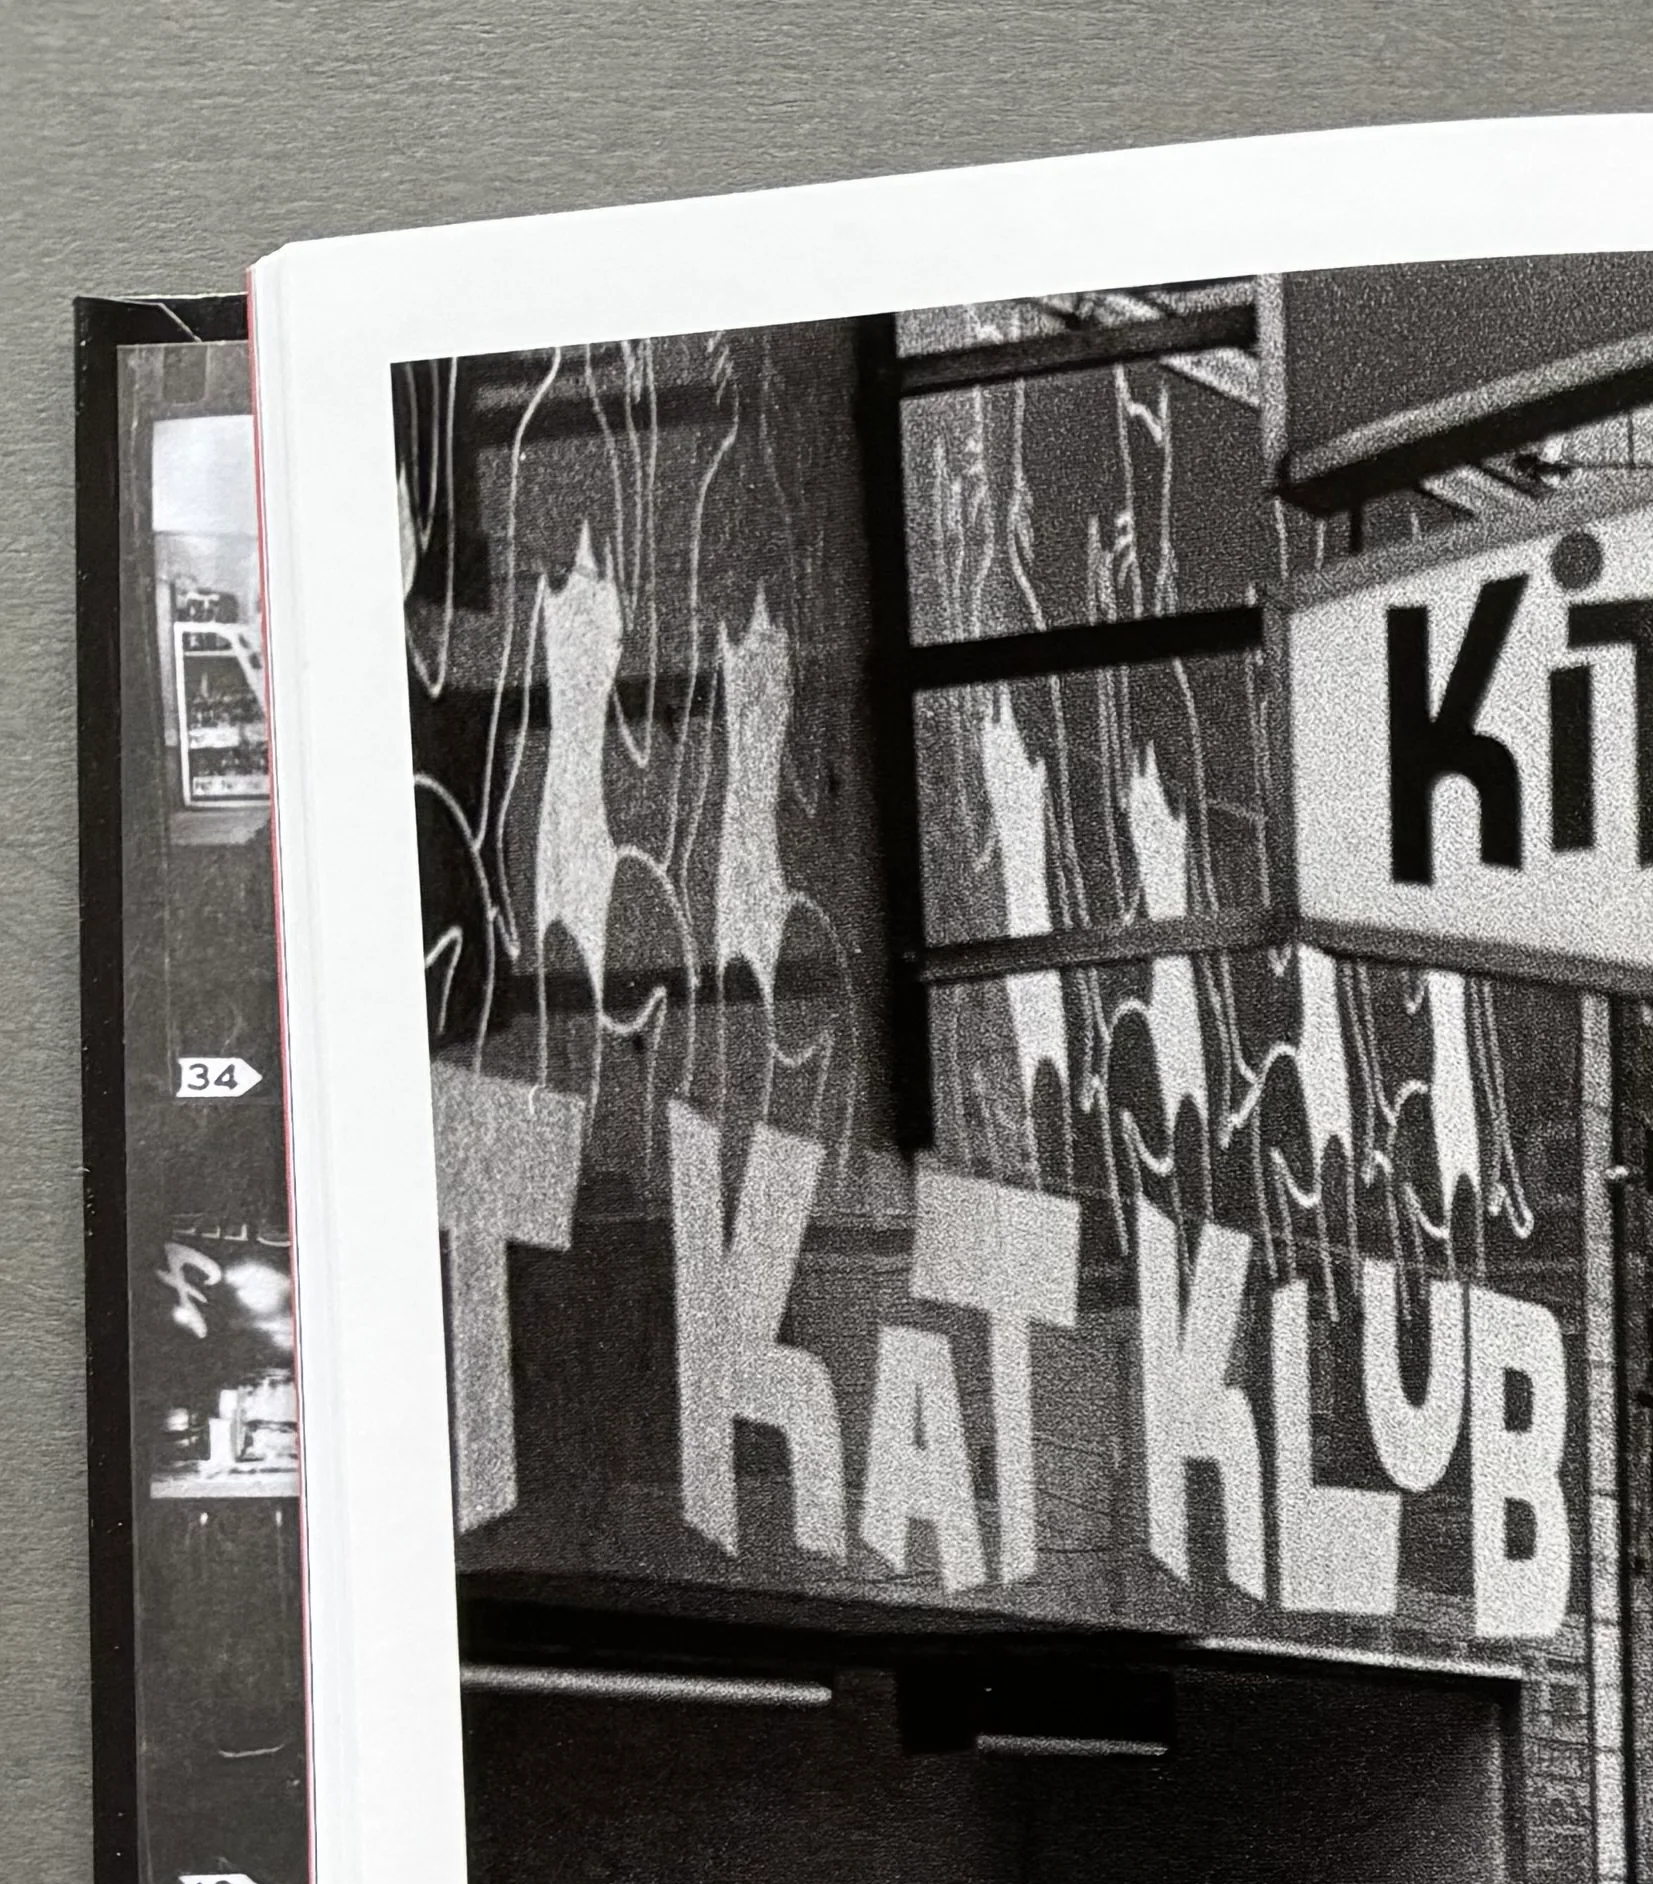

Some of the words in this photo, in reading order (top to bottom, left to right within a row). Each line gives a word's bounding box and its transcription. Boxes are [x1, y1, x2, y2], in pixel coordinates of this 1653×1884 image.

[187, 1065, 238, 1090] 34
[667, 1096, 1080, 1594] KAT
[1136, 1200, 1571, 1640] KLUB
